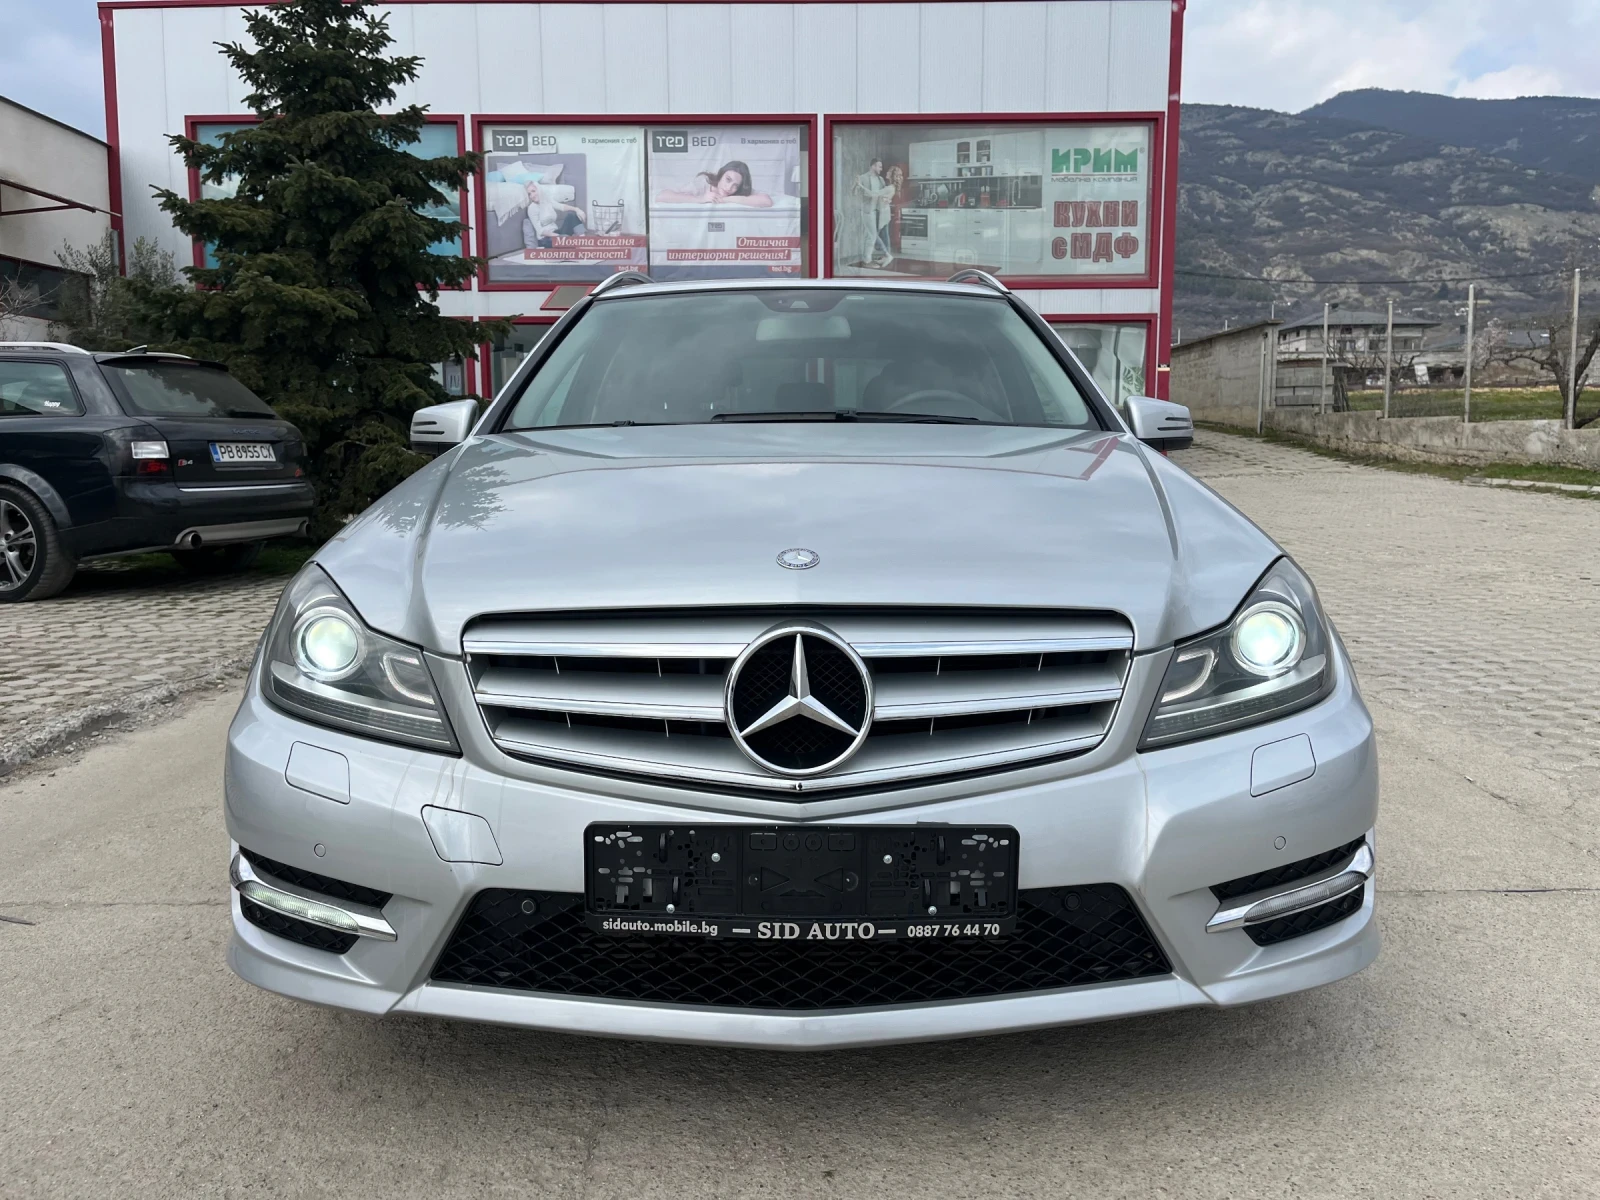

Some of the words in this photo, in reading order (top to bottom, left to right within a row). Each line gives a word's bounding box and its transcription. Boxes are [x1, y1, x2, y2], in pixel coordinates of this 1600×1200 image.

[532, 136, 556, 146] BED
[692, 137, 716, 146] BED
[1051, 148, 1138, 173] ИРИМ
[1053, 200, 1138, 228] КУХНИ
[555, 236, 594, 246] Моята
[597, 238, 636, 247] спалня
[738, 238, 788, 247] Отлични
[1070, 232, 1140, 263] МДФ
[578, 250, 628, 261] крепост!
[668, 252, 735, 262] интериорни
[738, 250, 788, 262] решения!
[218, 445, 235, 458] PB
[236, 446, 260, 458] 8955
[260, 445, 274, 459] CX
[602, 918, 718, 936] sidauto.mobile.bg
[756, 922, 800, 940] SID
[806, 922, 874, 939] AUTO
[906, 924, 940, 938] 0887
[943, 924, 960, 937] 76
[963, 924, 981, 936] 44
[984, 924, 1000, 936] 70
